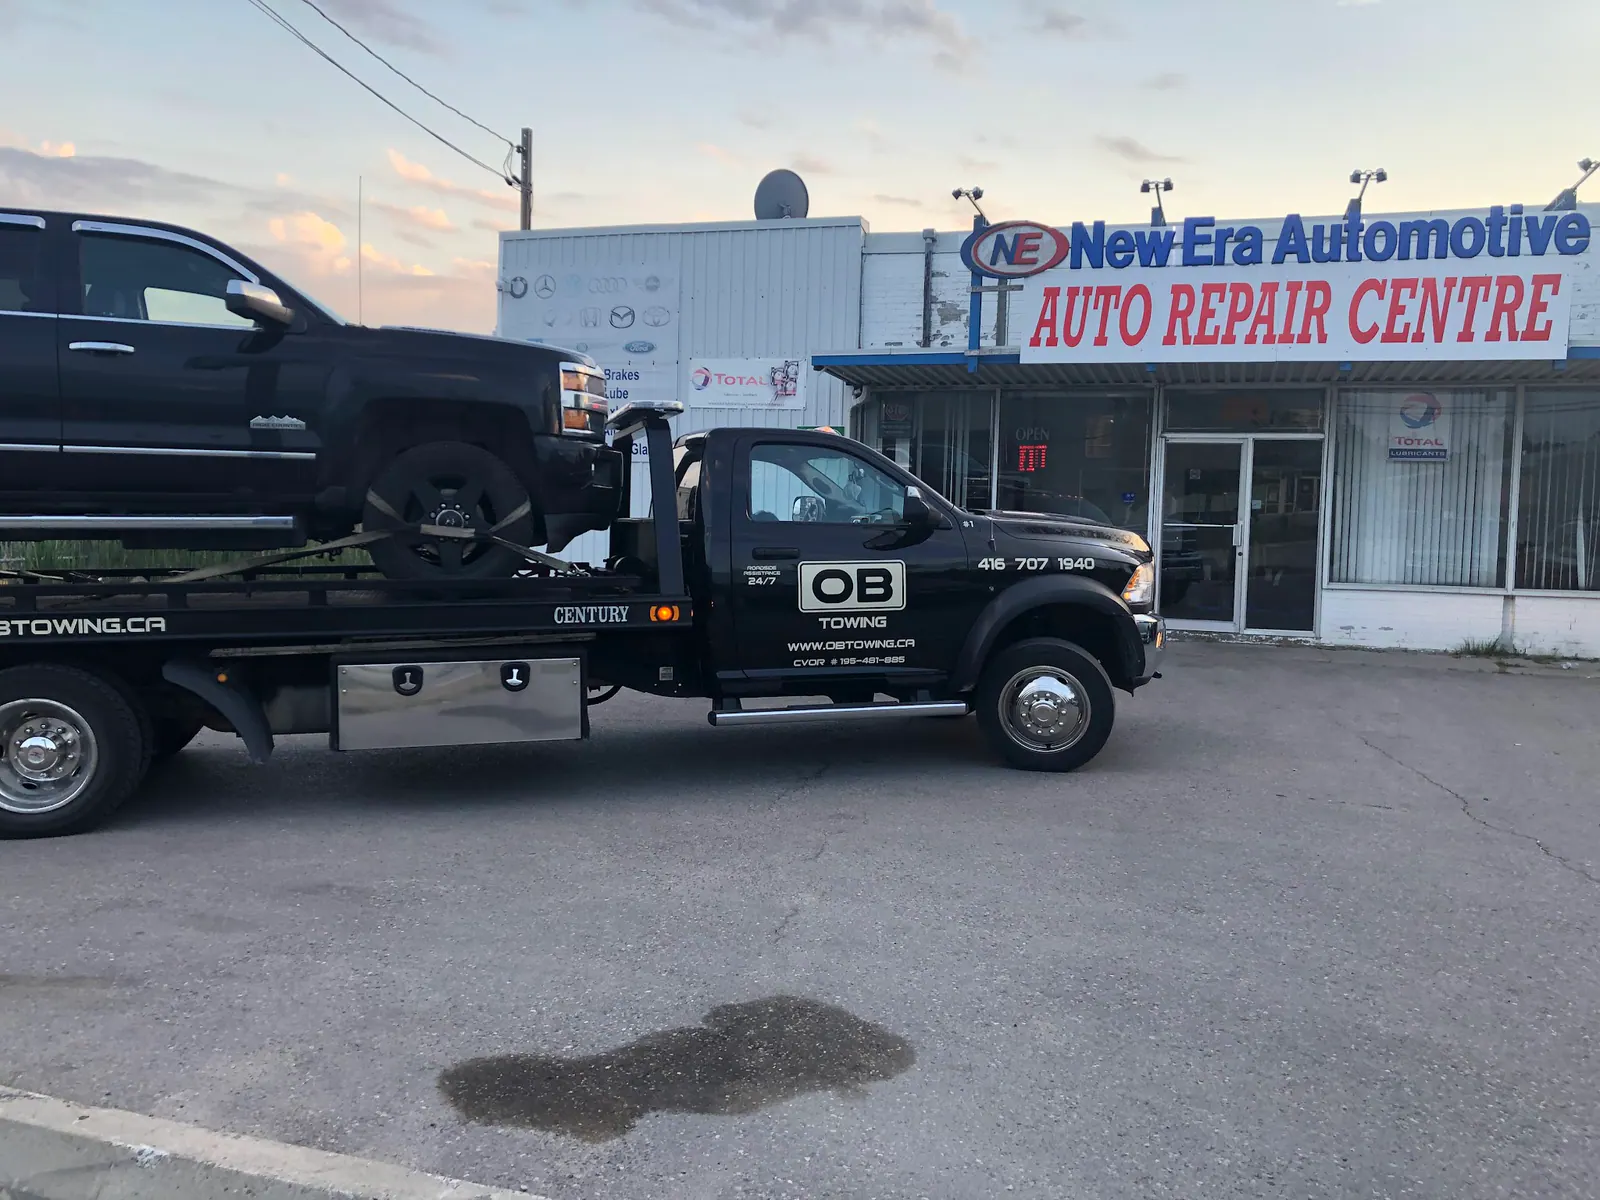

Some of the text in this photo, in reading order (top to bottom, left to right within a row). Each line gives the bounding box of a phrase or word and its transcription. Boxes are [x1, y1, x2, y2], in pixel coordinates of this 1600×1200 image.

[1069, 204, 1592, 270] New Era Automotive
[990, 233, 1044, 266] NE
[1029, 273, 1562, 347] AUTO REPAIR CENTRE
[604, 368, 640, 381] Brakes
[1015, 427, 1050, 441] OPEN
[1394, 436, 1444, 446] TOTAL
[977, 557, 1095, 571] 416 707 1940
[748, 576, 777, 586] 24/7
[811, 567, 894, 604] OB
[553, 605, 630, 624] CENTURY
[0, 616, 166, 636] BTOWING.CA
[818, 616, 888, 630] TOWING
[787, 638, 916, 652] WWW.OBTOWING.CA
[793, 658, 826, 667] CVOR
